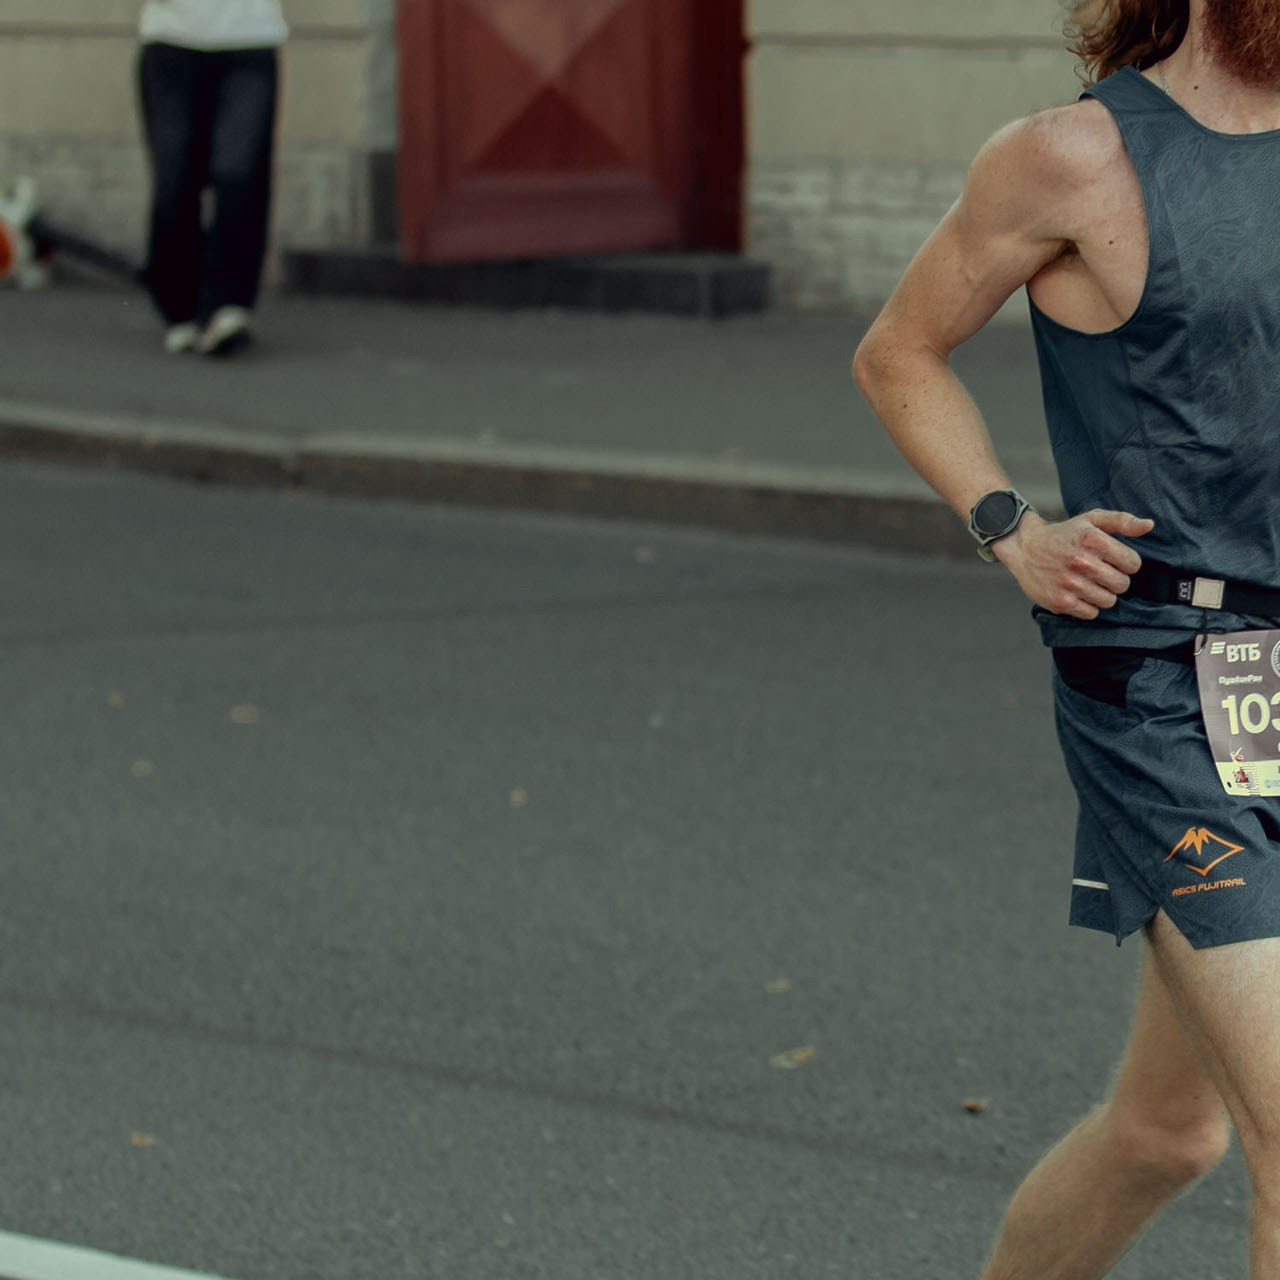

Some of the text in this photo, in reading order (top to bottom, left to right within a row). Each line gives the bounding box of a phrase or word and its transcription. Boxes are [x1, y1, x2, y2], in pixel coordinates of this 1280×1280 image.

[1226, 642, 1261, 663] ВТБ
[1171, 877, 1246, 897] ASICS FUJITRAIL
